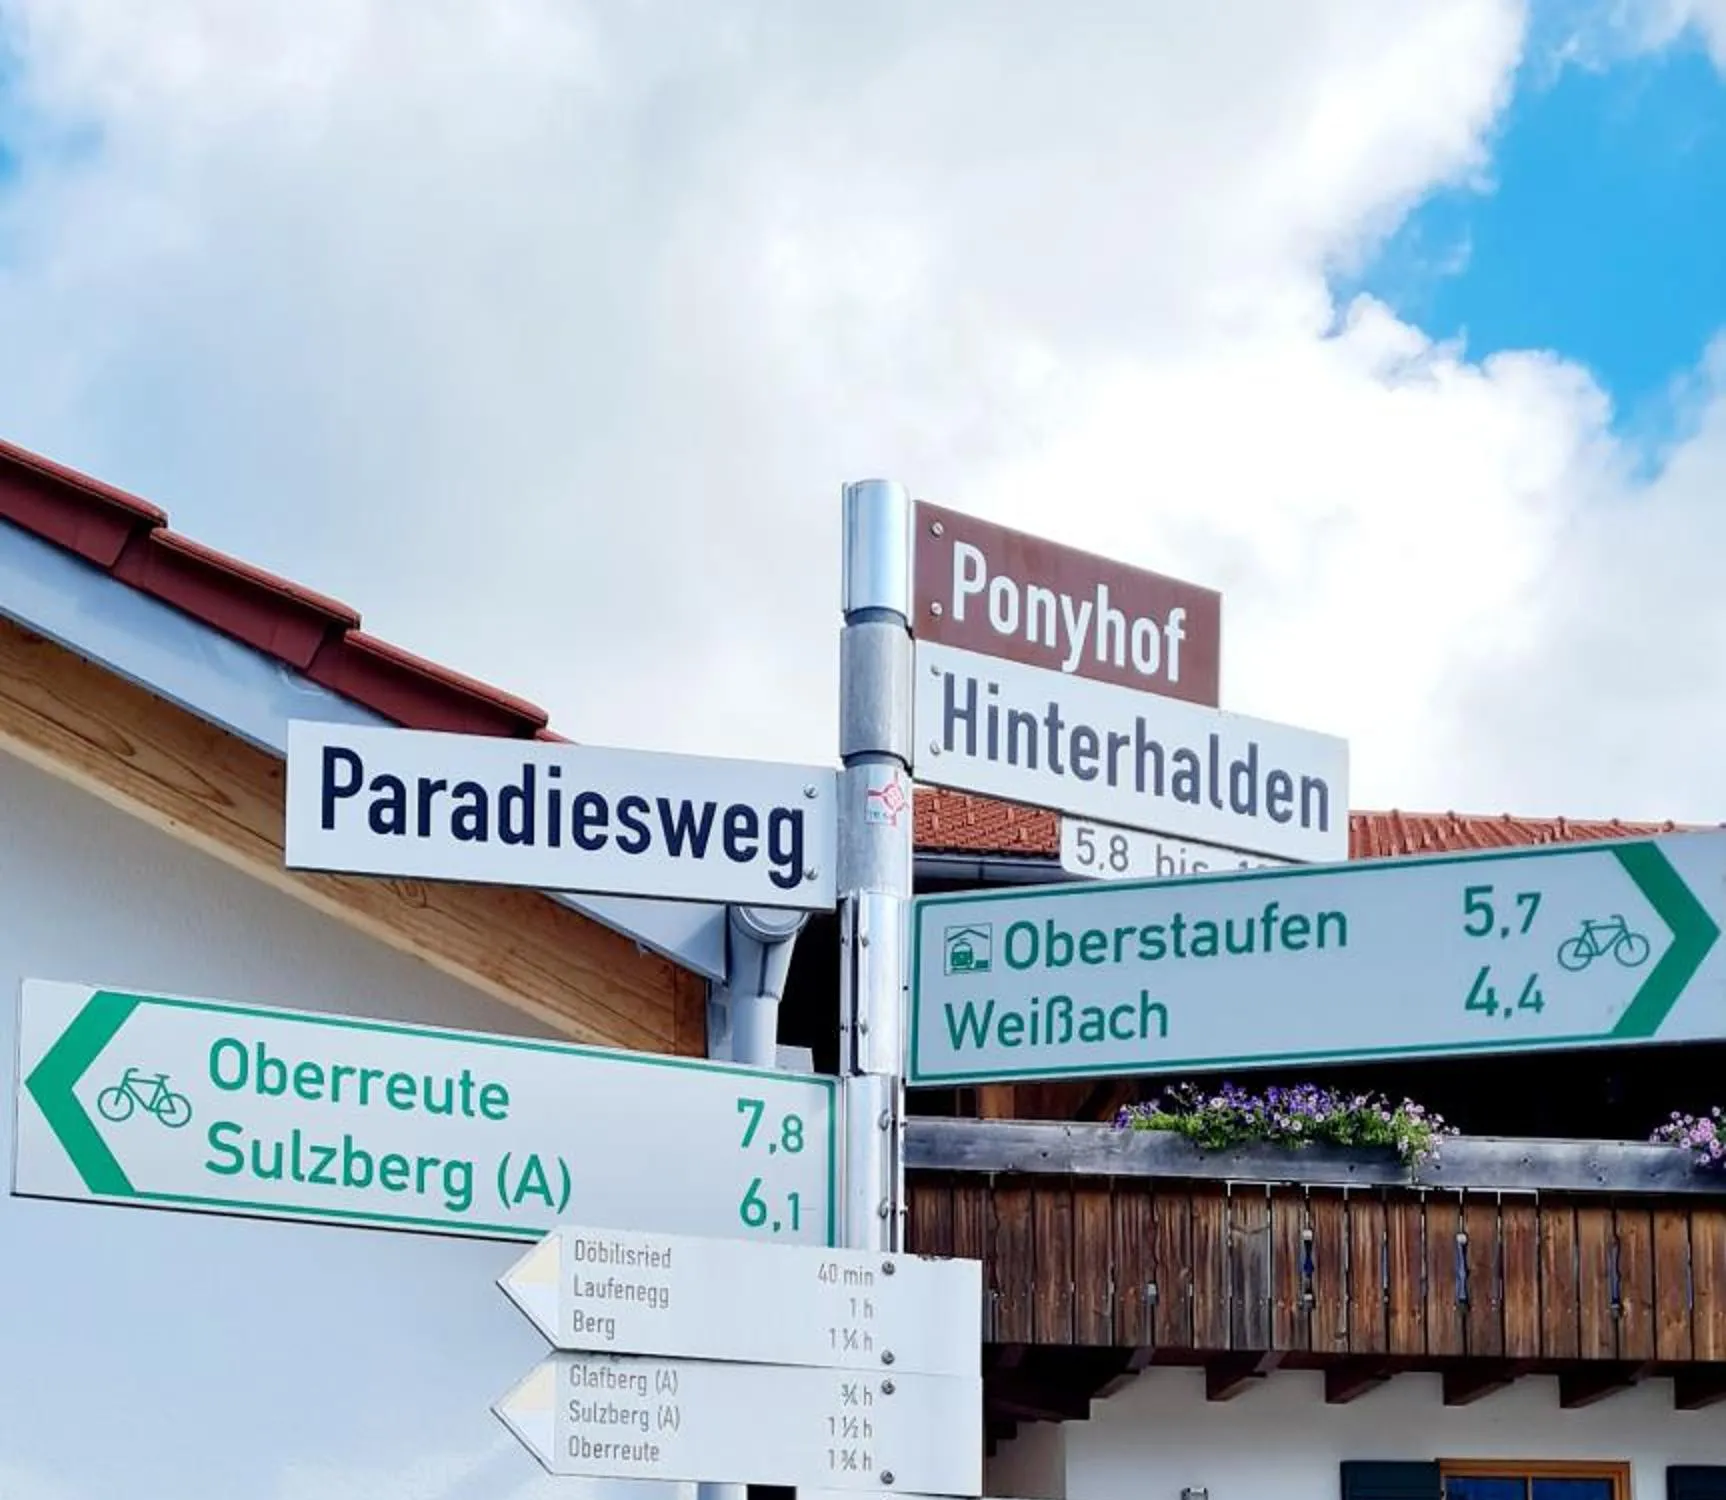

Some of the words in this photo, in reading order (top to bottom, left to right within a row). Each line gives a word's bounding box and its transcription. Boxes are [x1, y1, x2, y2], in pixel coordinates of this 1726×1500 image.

[952, 541, 1186, 683] Ponyhof
[943, 672, 1329, 833] Hinterhalden
[321, 745, 804, 889] Paradiesweg
[1076, 827, 1129, 872] 5,8
[1004, 903, 1348, 970] Oberstaufen
[1463, 884, 1542, 939] 5,7
[944, 991, 1169, 1050] Weißach
[1465, 966, 1545, 1019] 4,4
[207, 1037, 511, 1121] Oberreute
[737, 1097, 805, 1156] 7,8
[206, 1121, 475, 1211] Sulzberg
[496, 1152, 573, 1213] (A)
[740, 1177, 801, 1232] 6,1
[574, 1273, 669, 1309] Laufenegg
[849, 1297, 856, 1319] 1
[863, 1298, 873, 1319] h
[817, 1263, 837, 1284] 40
[843, 1266, 873, 1286] min
[573, 1309, 615, 1340] Berg
[863, 1330, 873, 1353] h
[569, 1363, 647, 1396] Glafberg
[655, 1368, 678, 1396] (A)
[863, 1384, 872, 1406] h
[569, 1399, 649, 1432] Sulzberg
[657, 1404, 680, 1432] (A)
[863, 1417, 872, 1438] h
[568, 1435, 660, 1462] Oberreute
[863, 1449, 872, 1471] h
